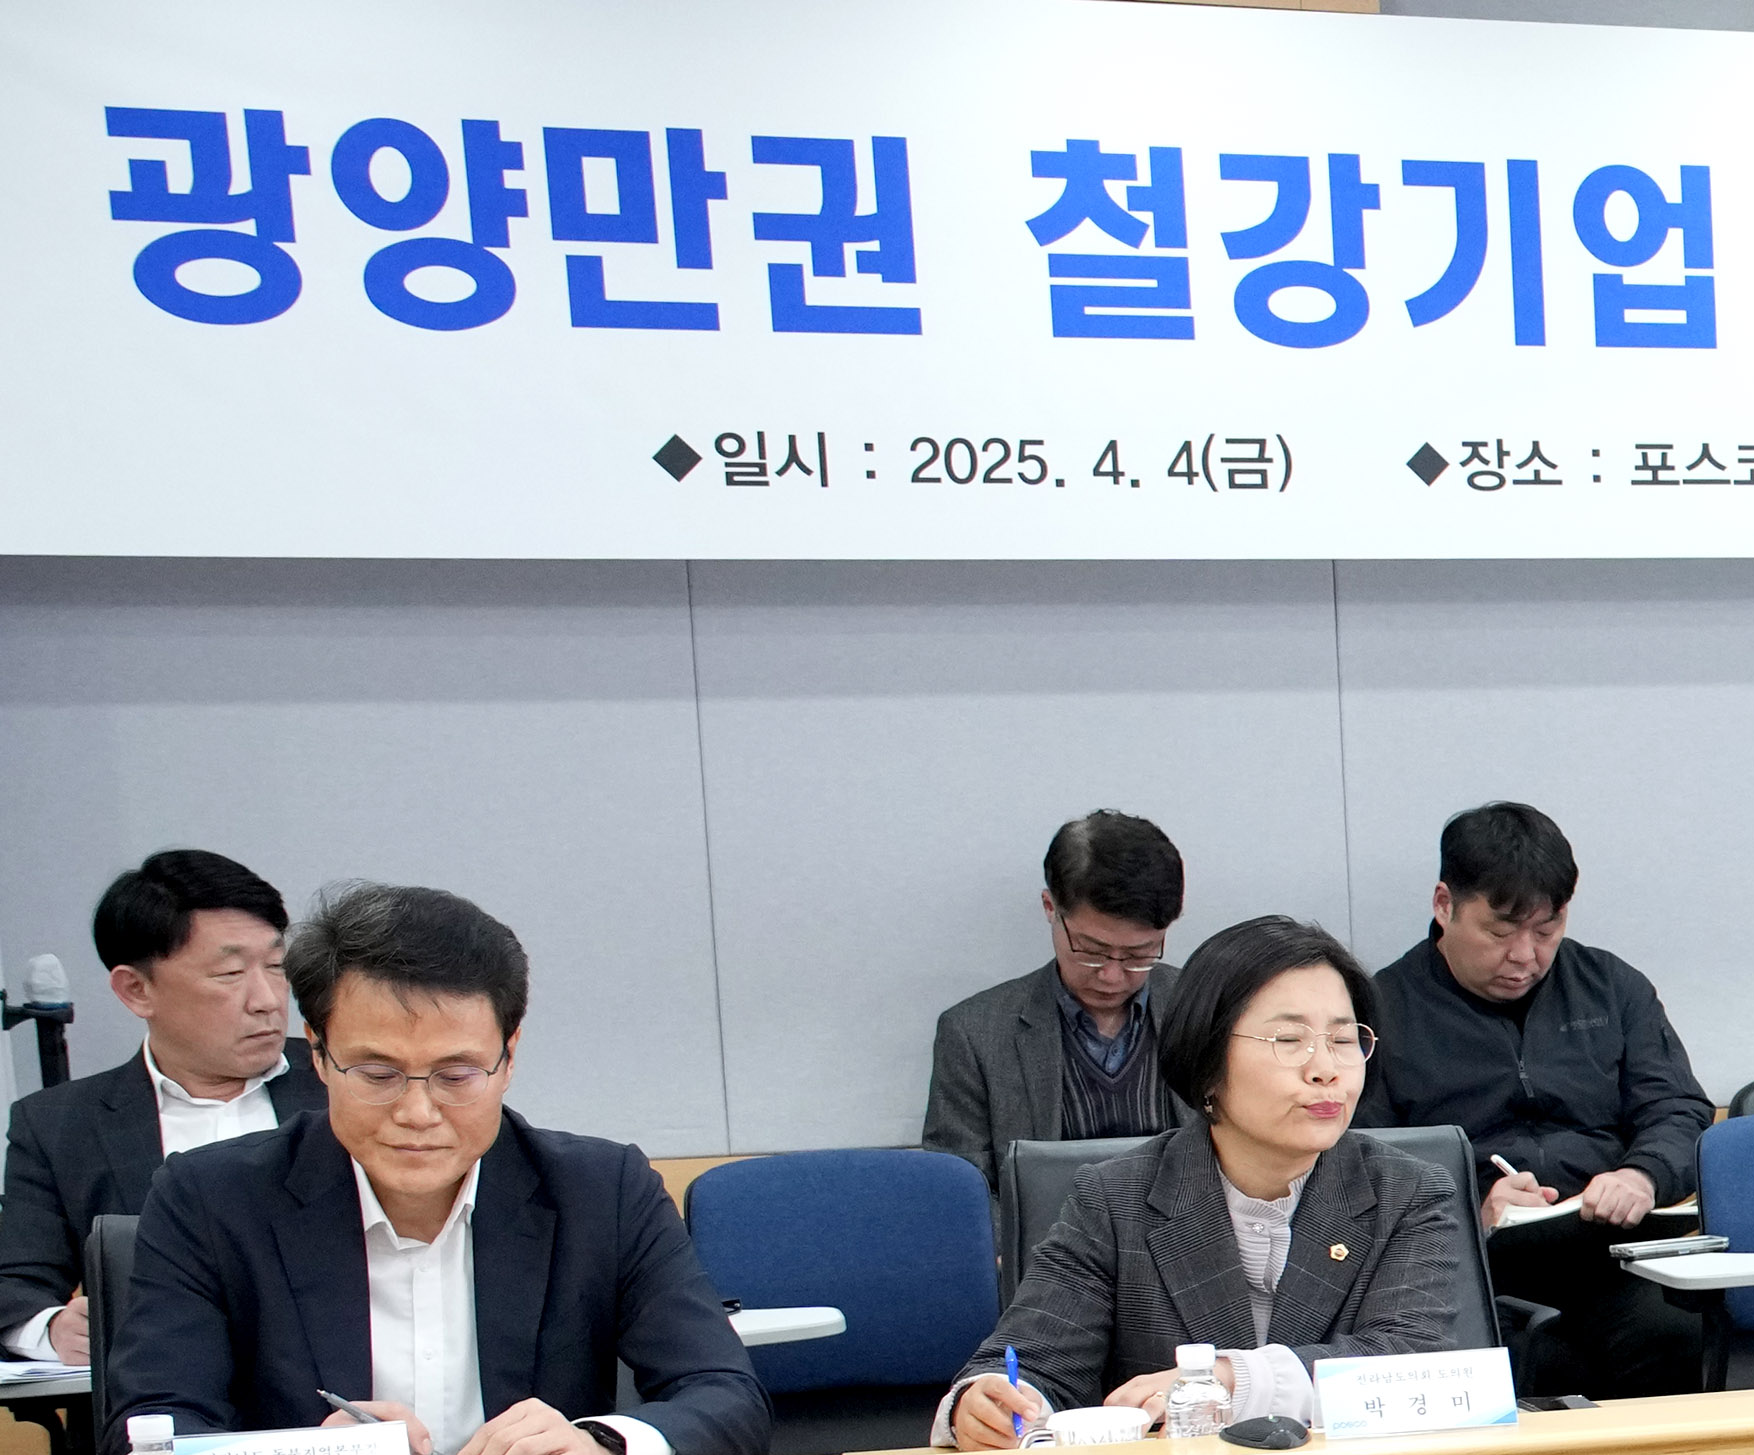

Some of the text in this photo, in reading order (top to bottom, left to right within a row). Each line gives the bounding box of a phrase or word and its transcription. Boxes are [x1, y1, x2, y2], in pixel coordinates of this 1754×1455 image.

[103, 105, 923, 336] 광양만권
[1024, 138, 1718, 350] 철강기업
[713, 430, 829, 488] 일시
[909, 436, 1066, 488] 2025.
[1092, 439, 1141, 489] 4.
[1166, 433, 1293, 493] 4(금)
[1458, 438, 1563, 492] 장소
